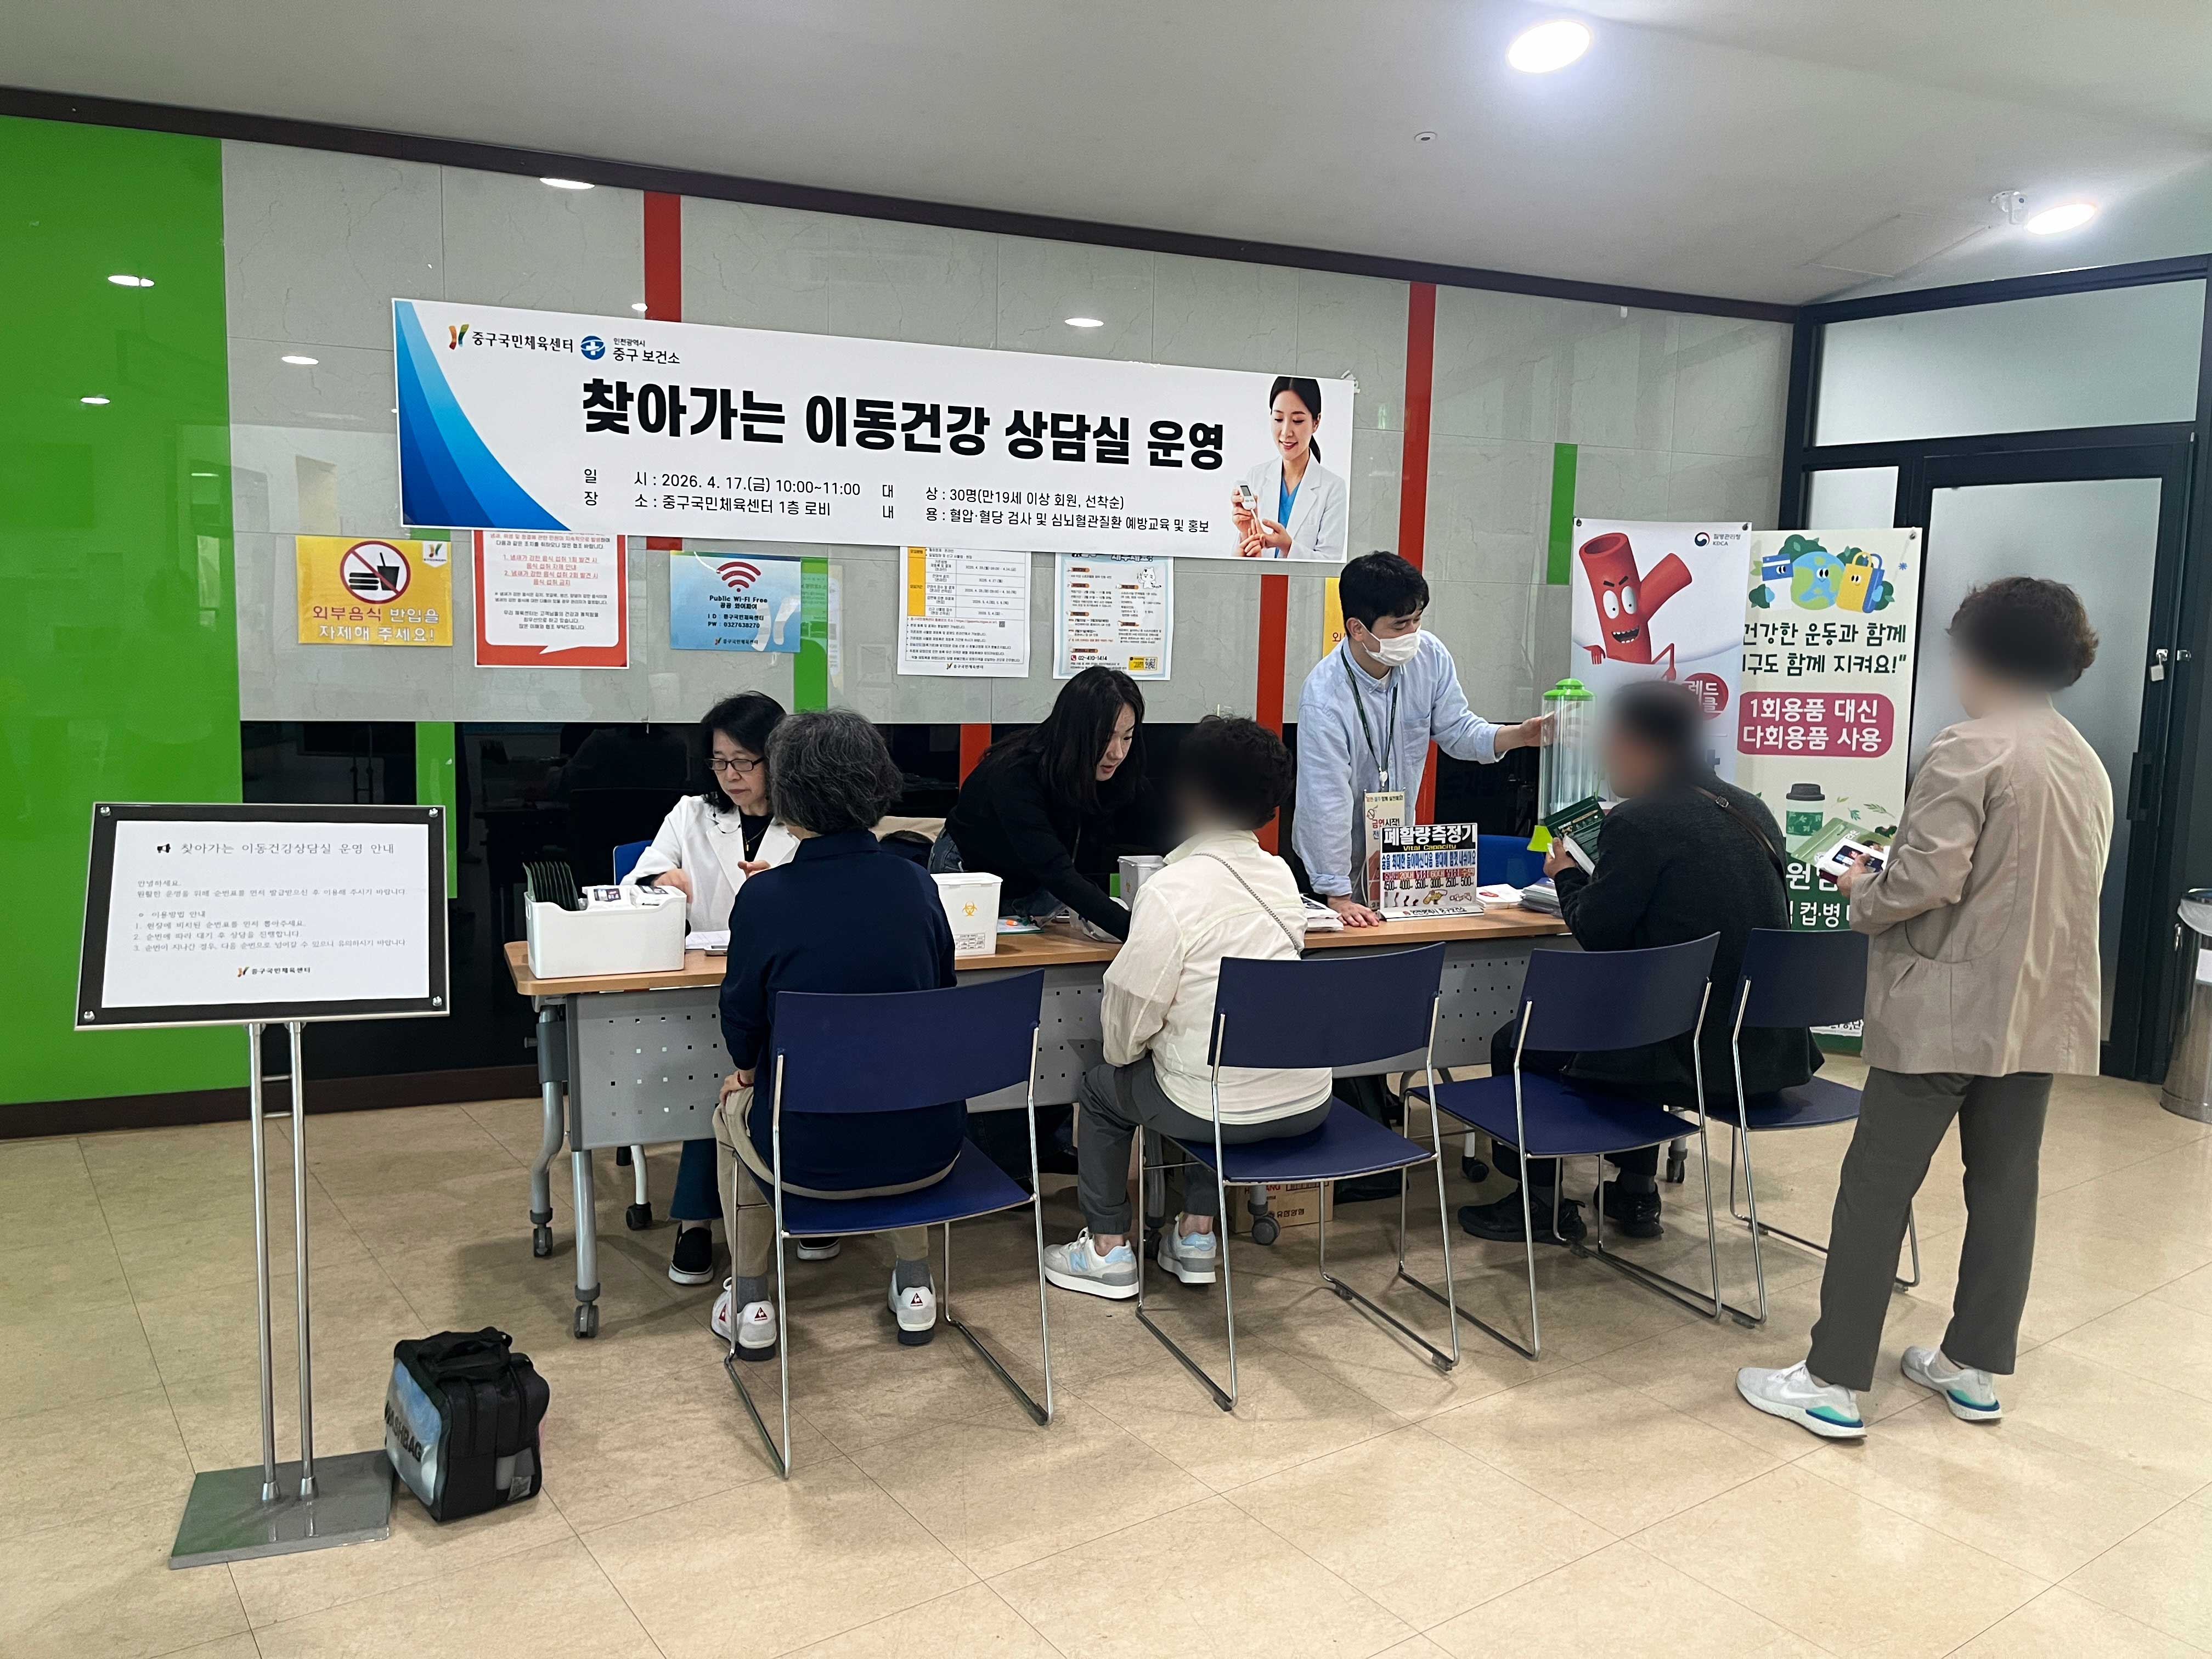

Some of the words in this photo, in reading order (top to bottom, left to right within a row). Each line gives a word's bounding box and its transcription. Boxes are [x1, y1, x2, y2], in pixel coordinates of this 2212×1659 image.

[472, 331, 573, 353] 중구국민체육센터
[613, 337, 646, 347] 인천광역시
[613, 348, 639, 362] 중구
[642, 350, 680, 364] 보건소
[583, 378, 785, 443] 찾아가는
[806, 395, 990, 456] 이동건강
[1005, 410, 1129, 465] 상담실
[1147, 420, 1223, 470] 운영
[584, 469, 597, 484] 일
[634, 471, 647, 486] 시
[662, 474, 702, 488] 2026.
[708, 476, 720, 489] 4.
[726, 477, 770, 493] 17.(금)
[776, 479, 861, 495] 10:00~11:00
[584, 492, 599, 506] 장
[635, 494, 648, 507] 소
[662, 495, 774, 514] 중구국민체육센터
[779, 500, 799, 515] 1층
[805, 502, 831, 516] 로비
[882, 484, 894, 498] 대
[926, 487, 938, 500] 상
[950, 489, 1022, 505] 30명(만19세
[1026, 493, 1050, 506] 이상
[1054, 494, 1081, 508] 회원,
[1085, 496, 1124, 510] 선착순)
[882, 505, 894, 520] 내
[926, 509, 938, 522] 용
[950, 509, 1003, 524] 혈압·혈당
[1008, 512, 1031, 526] 검사
[1036, 512, 1047, 526] 및
[1051, 513, 1122, 529] 심뇌혈관질환
[1126, 517, 1170, 531] 예방교육
[1174, 519, 1184, 532] 및
[1188, 520, 1210, 533] 홍보
[313, 606, 381, 622] 외부음식
[390, 608, 439, 623] 반입을
[319, 625, 369, 641] 자제해
[378, 627, 435, 641] 주세요!
[1743, 622, 1798, 646] 건강한
[1805, 622, 1859, 646] 운동과
[1866, 622, 1906, 647] 함께
[1787, 652, 1825, 676] 함께
[1750, 698, 1826, 723] 1회용품
[1835, 699, 1878, 724] 대신
[1743, 725, 1829, 751] 다회용품
[1837, 727, 1882, 752] 사용
[1372, 819, 1385, 828] 금연
[1385, 818, 1400, 826] 시작!
[1384, 825, 1476, 846] 폐활량측정기
[181, 843, 234, 854] 찾아가는
[242, 843, 331, 854] 이동건강상담실
[338, 844, 362, 854] 운영
[370, 843, 394, 854] 안내
[1382, 854, 1390, 870] 숨을
[1392, 853, 1406, 870] 최대한
[1400, 871, 1414, 879] 20대
[252, 967, 311, 975] 중구국민체육센터
